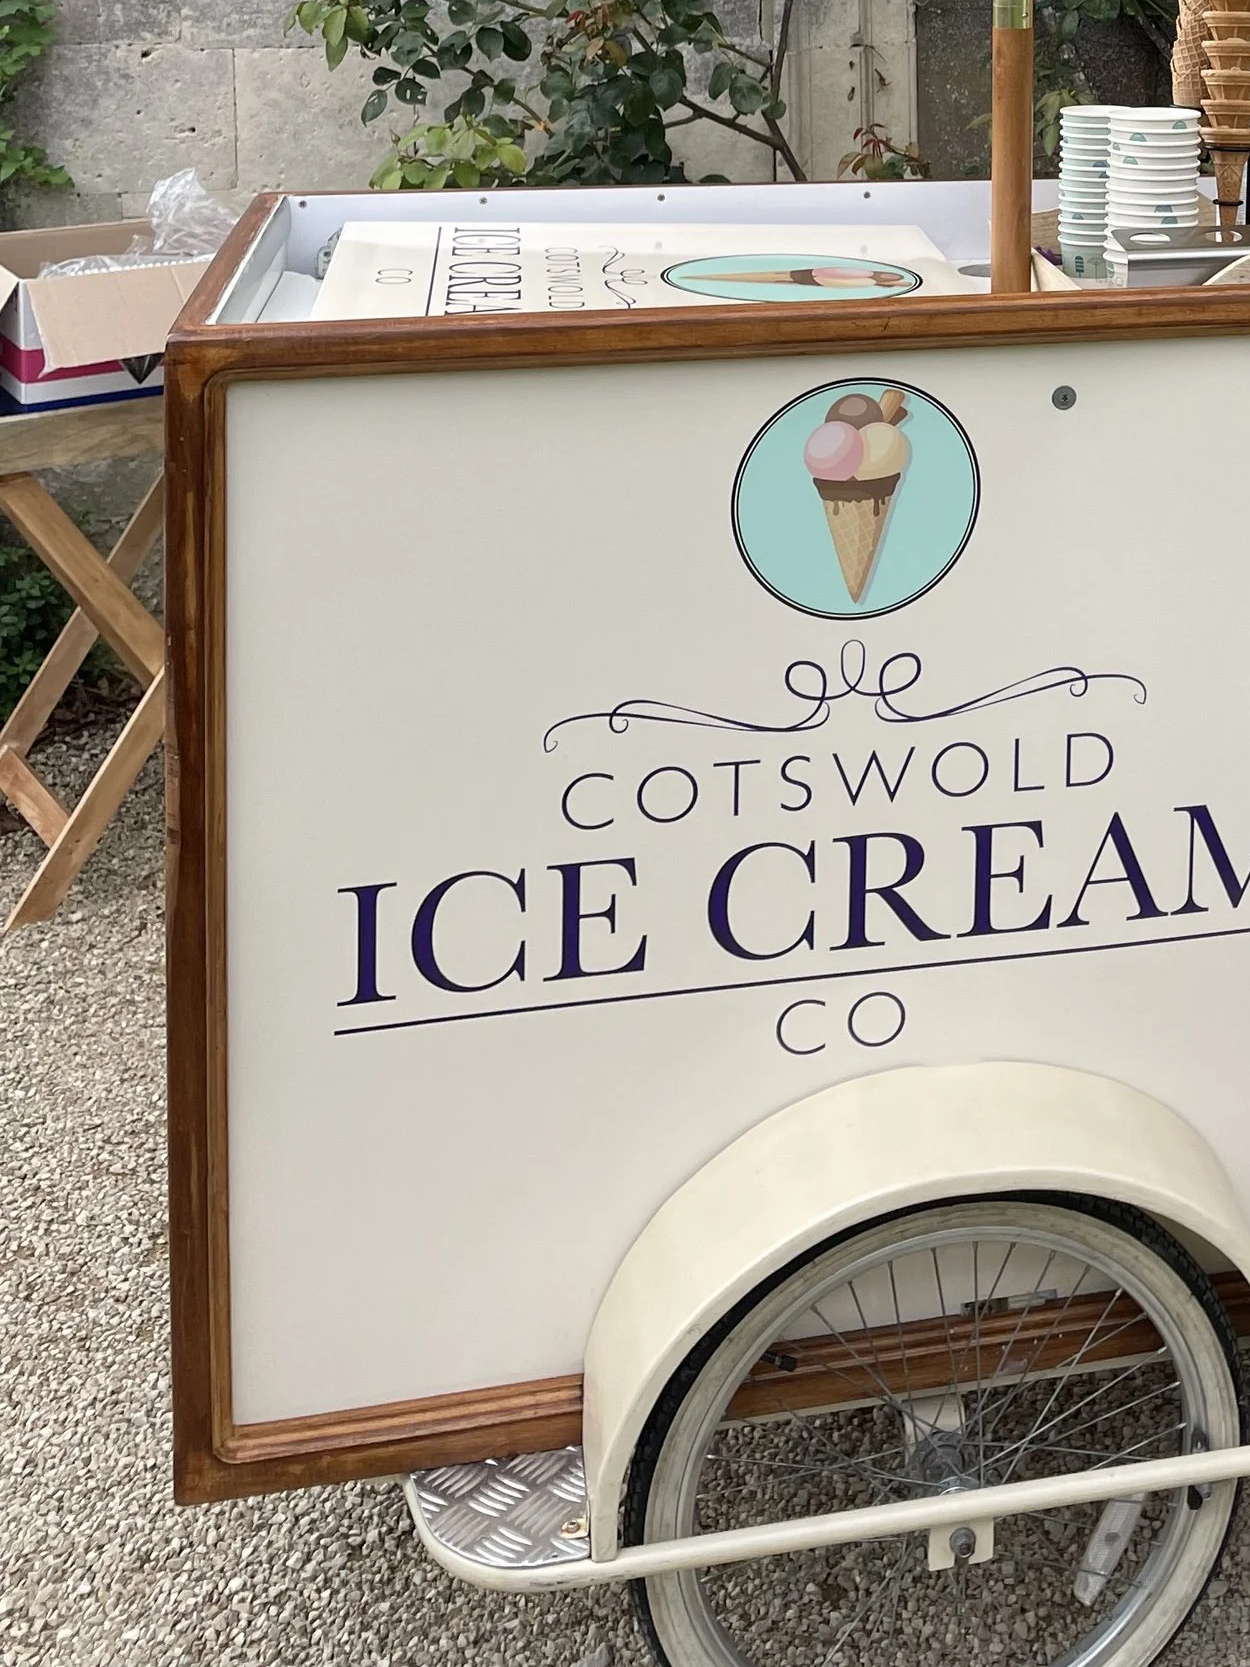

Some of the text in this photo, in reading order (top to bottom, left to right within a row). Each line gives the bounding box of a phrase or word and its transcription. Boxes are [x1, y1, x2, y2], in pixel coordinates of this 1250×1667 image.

[375, 268, 413, 284] CO
[444, 227, 522, 316] ICE CREA
[561, 732, 1114, 830] COTSWOLD
[336, 856, 648, 1007] ICE
[776, 991, 906, 1056] CO
